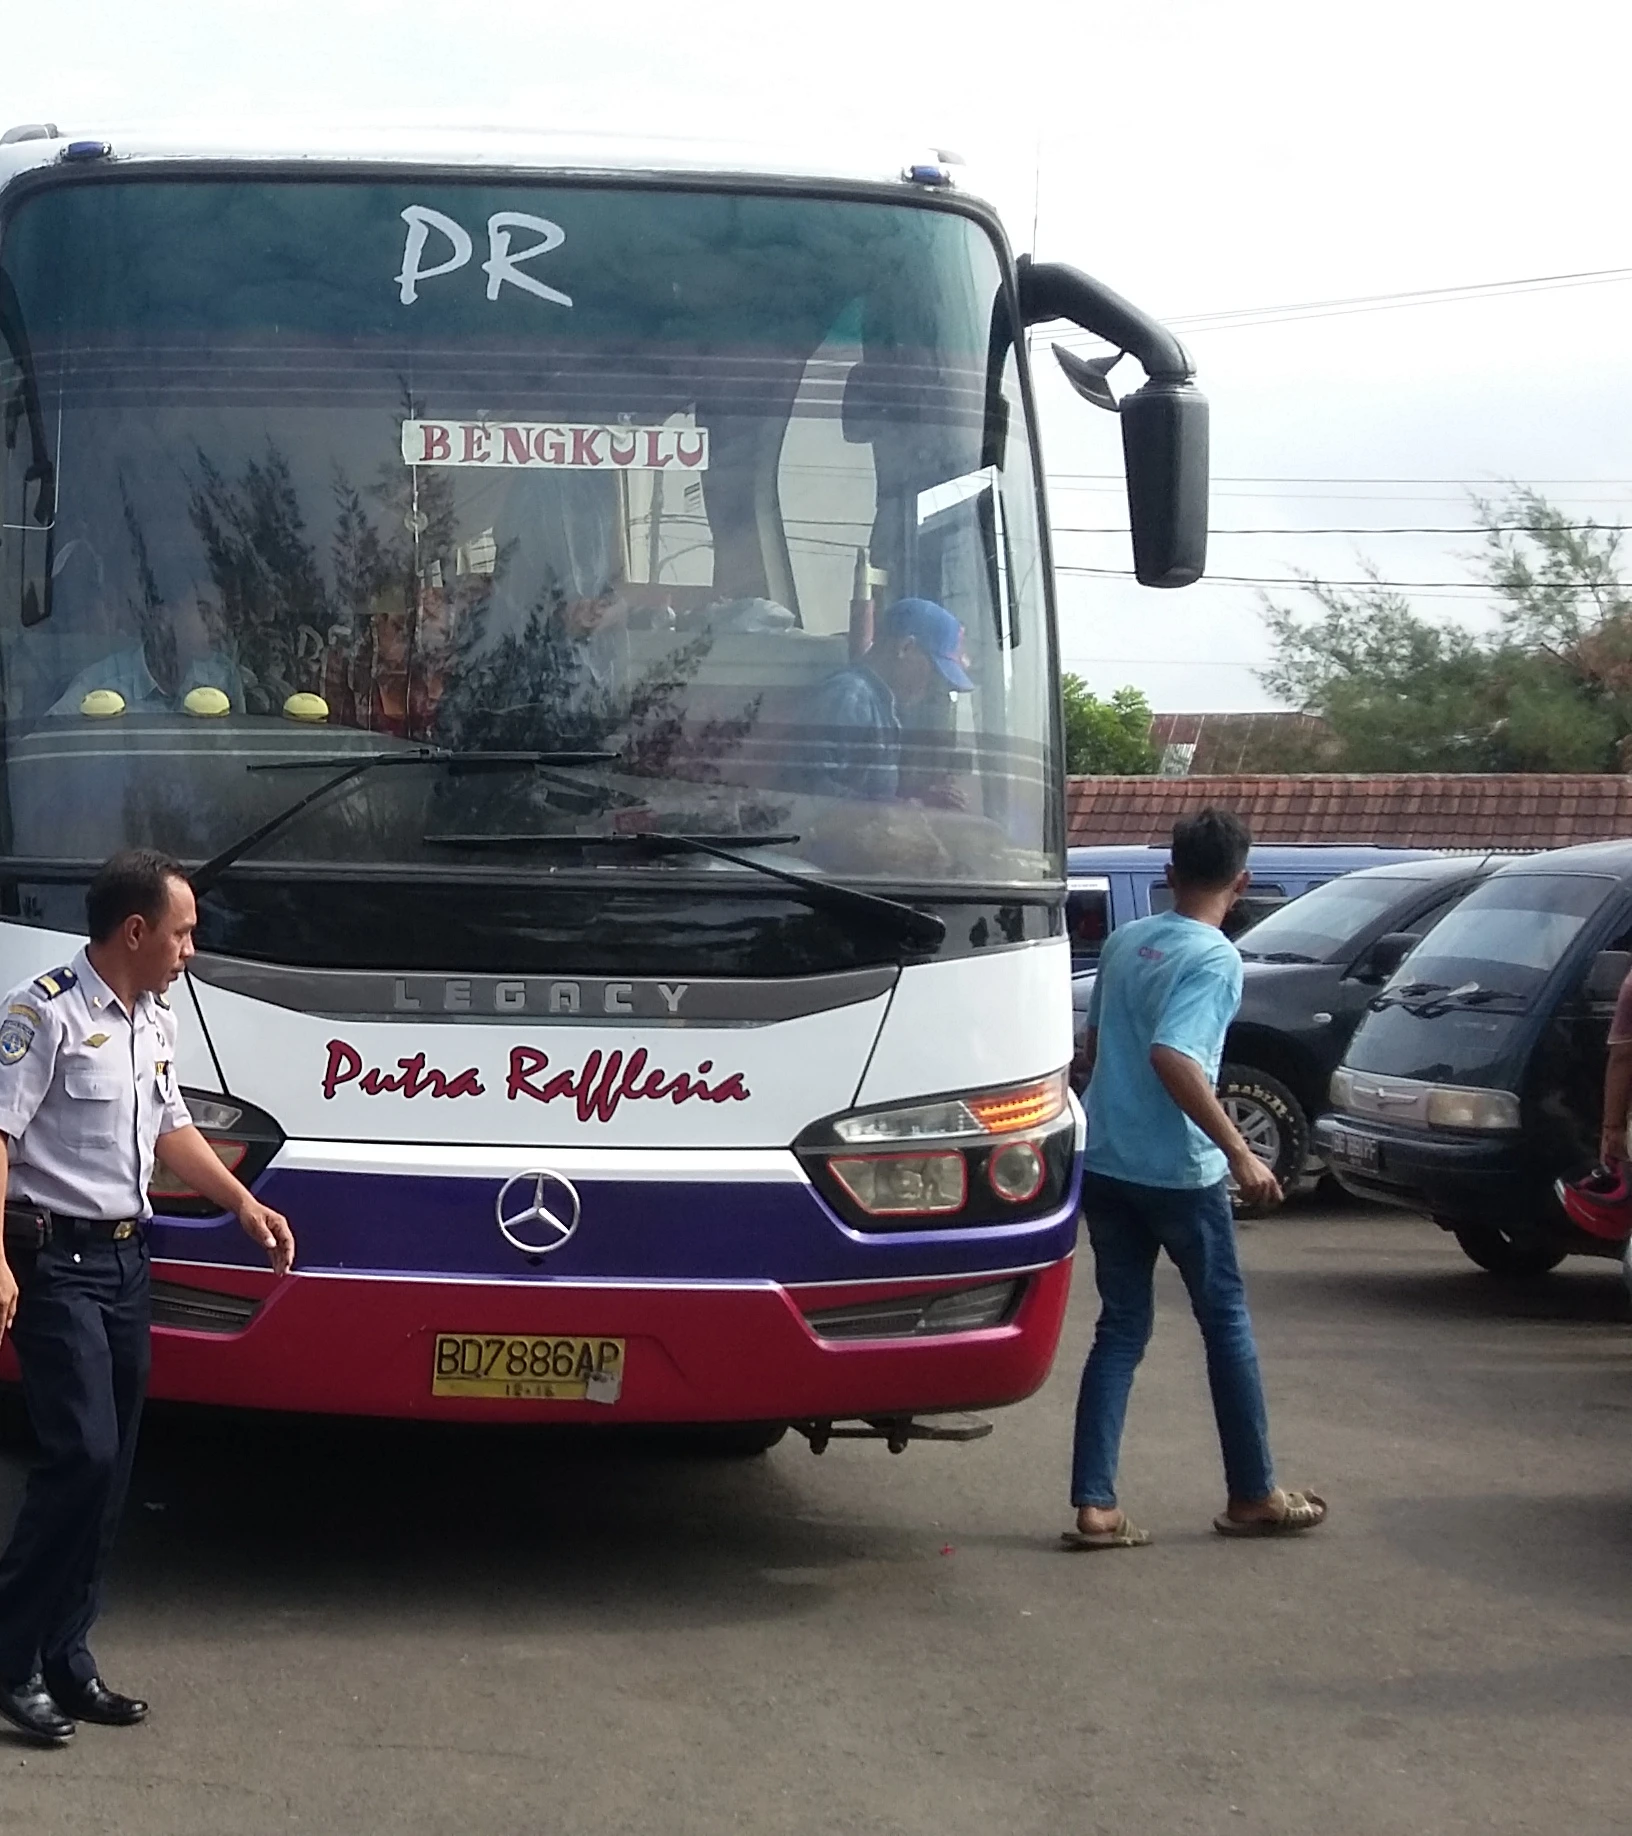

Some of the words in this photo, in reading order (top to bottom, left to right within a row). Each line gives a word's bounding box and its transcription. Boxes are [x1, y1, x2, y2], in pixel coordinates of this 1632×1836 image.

[394, 205, 573, 307] PR
[419, 423, 707, 468] BENGKULU
[394, 979, 689, 1013] LEGACY
[322, 1038, 486, 1100] Putra
[506, 1045, 752, 1123] Rafflesia
